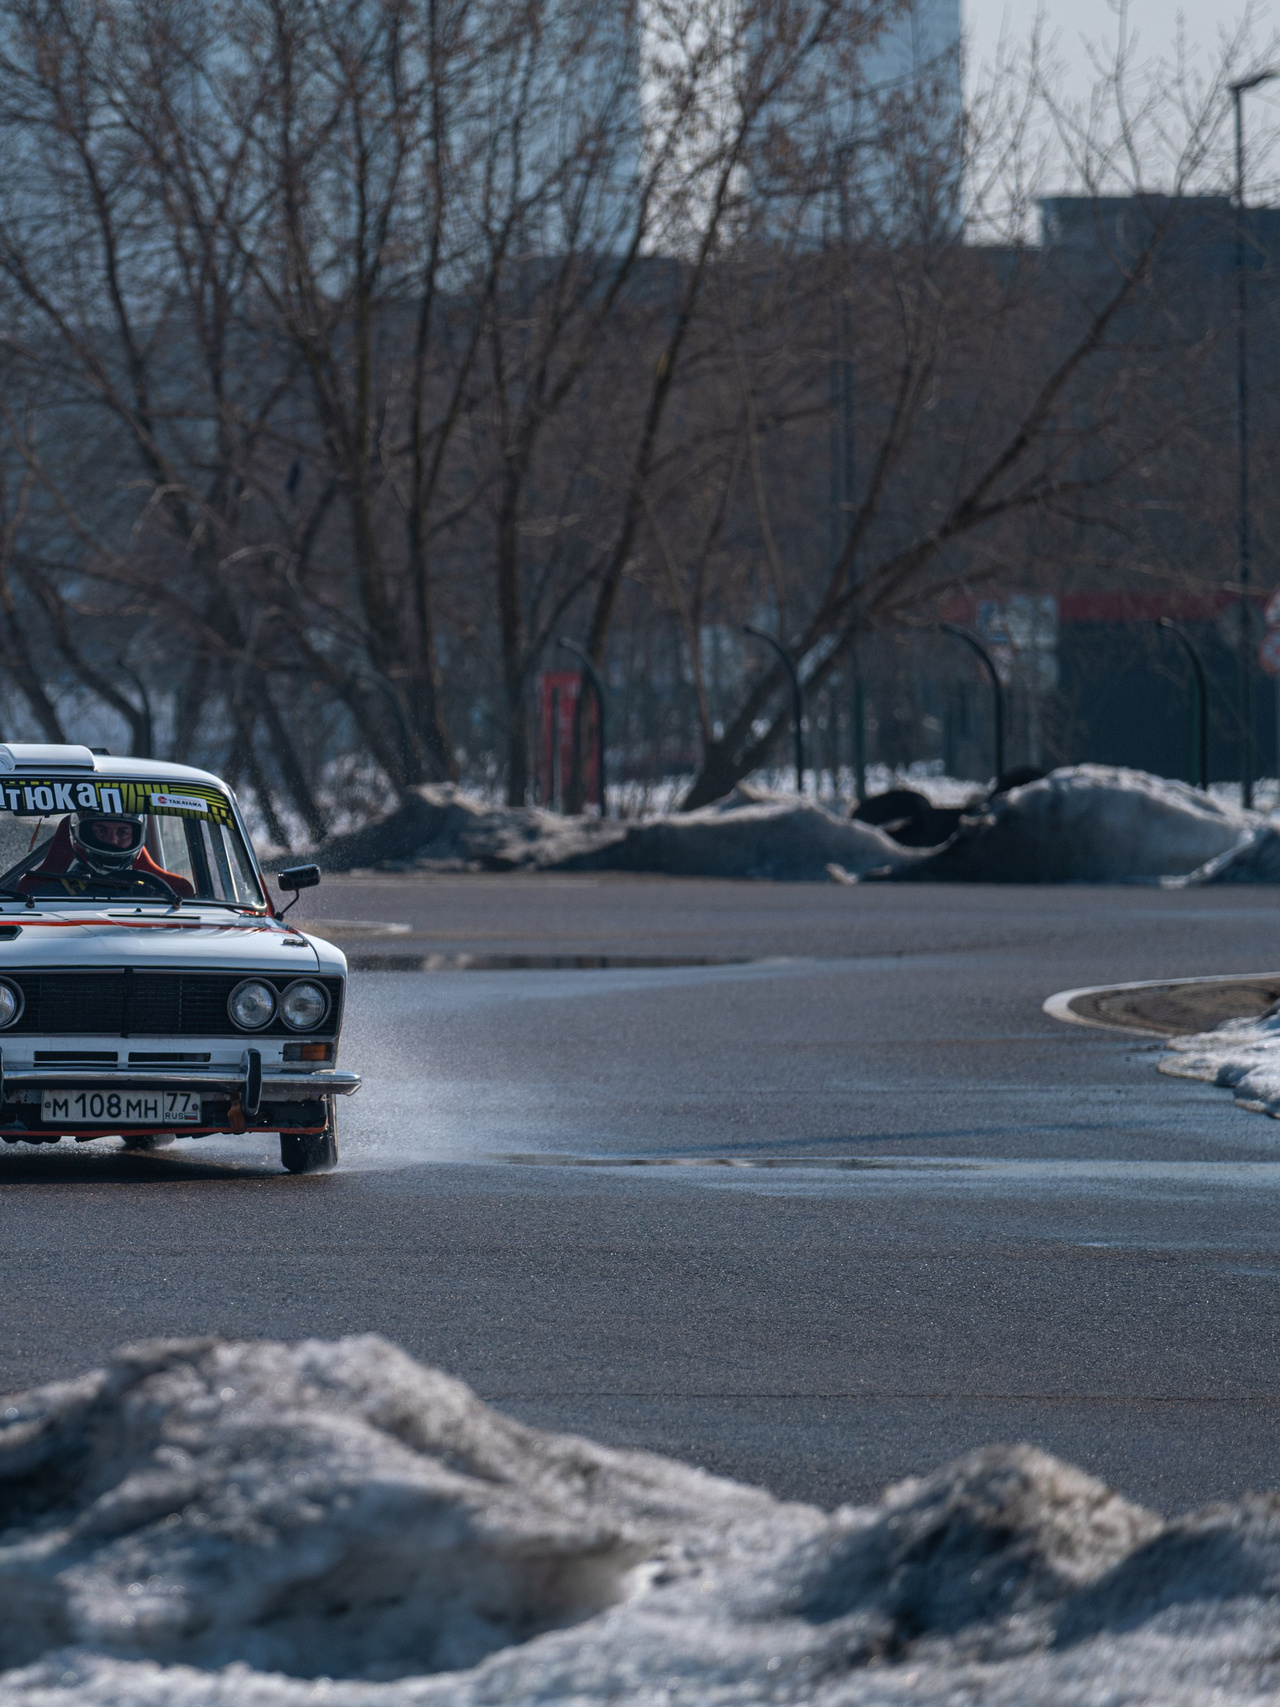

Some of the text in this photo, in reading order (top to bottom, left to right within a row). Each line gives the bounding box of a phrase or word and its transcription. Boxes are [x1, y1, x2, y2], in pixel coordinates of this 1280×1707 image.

[169, 799, 202, 807] TAKAYAMA
[166, 1092, 191, 1112] 77
[165, 1112, 184, 1120] RUS
